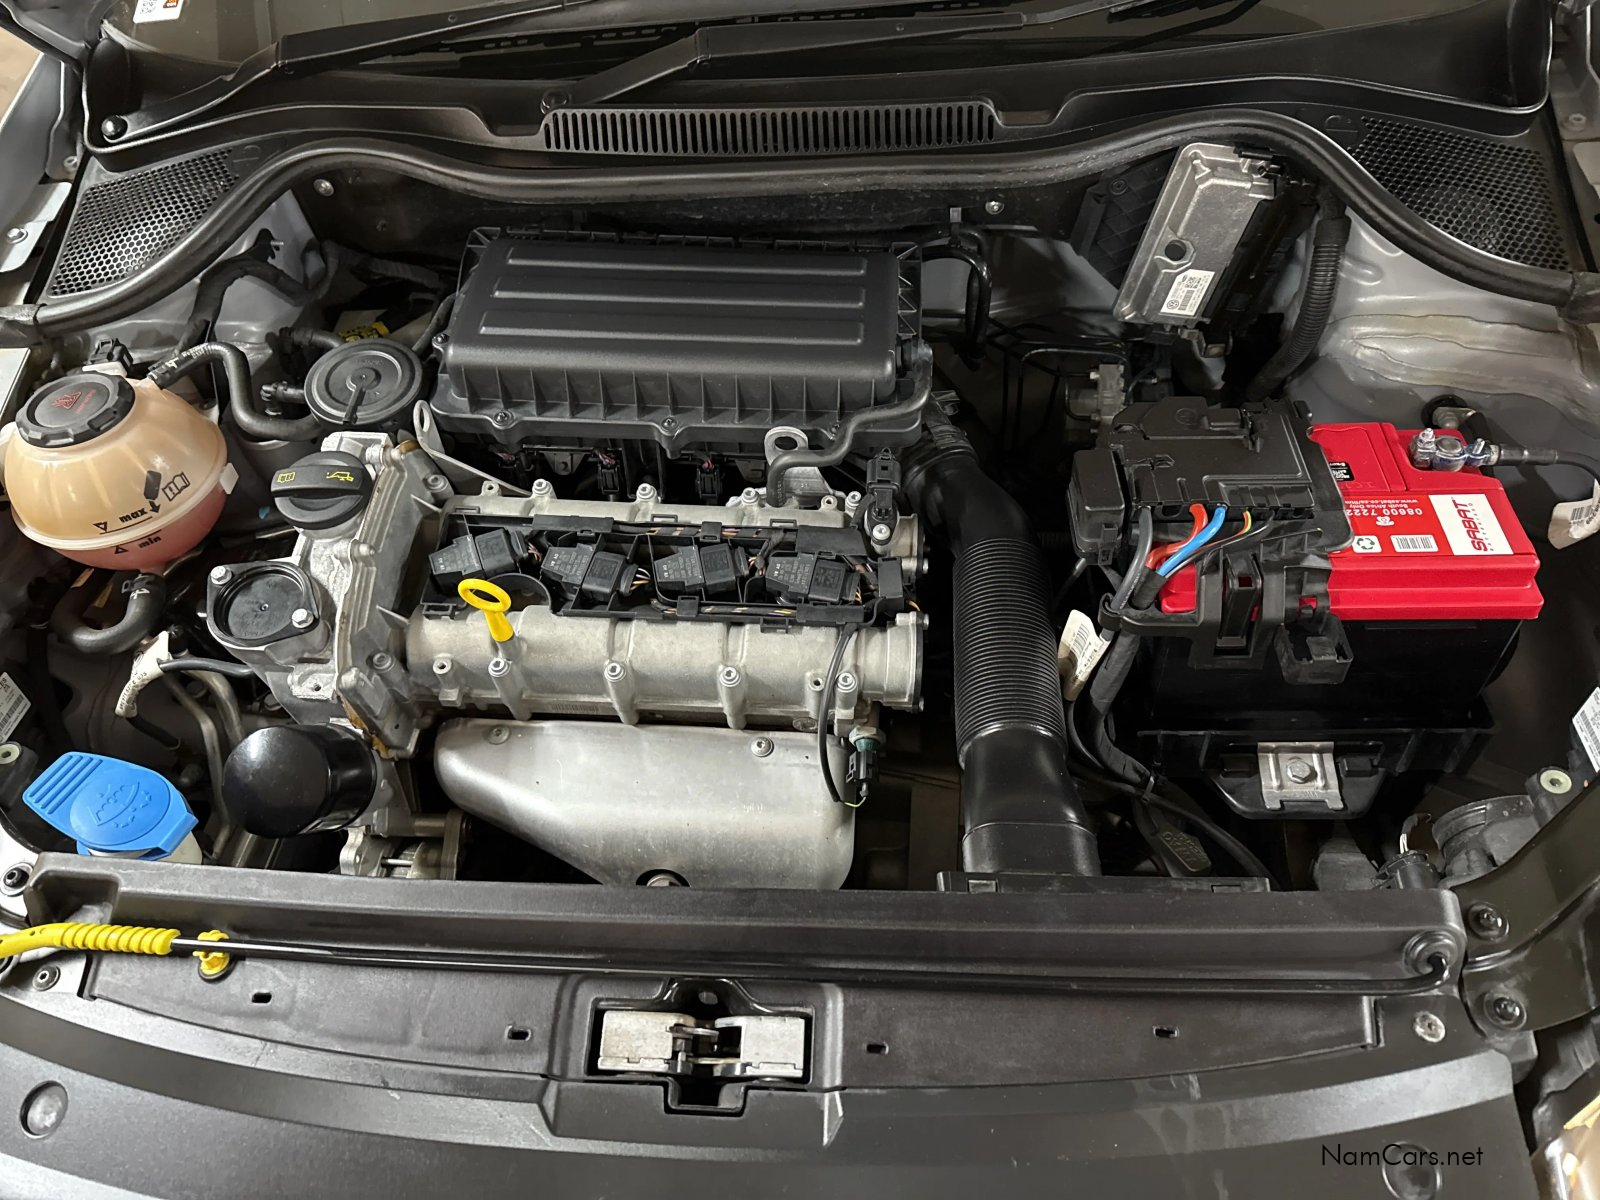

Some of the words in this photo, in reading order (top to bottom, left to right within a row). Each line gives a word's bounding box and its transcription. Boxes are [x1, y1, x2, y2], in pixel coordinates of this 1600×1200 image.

[118, 507, 148, 523] max
[1382, 508, 1423, 516] 08600
[1452, 499, 1489, 552] SABAT
[138, 536, 162, 548] min
